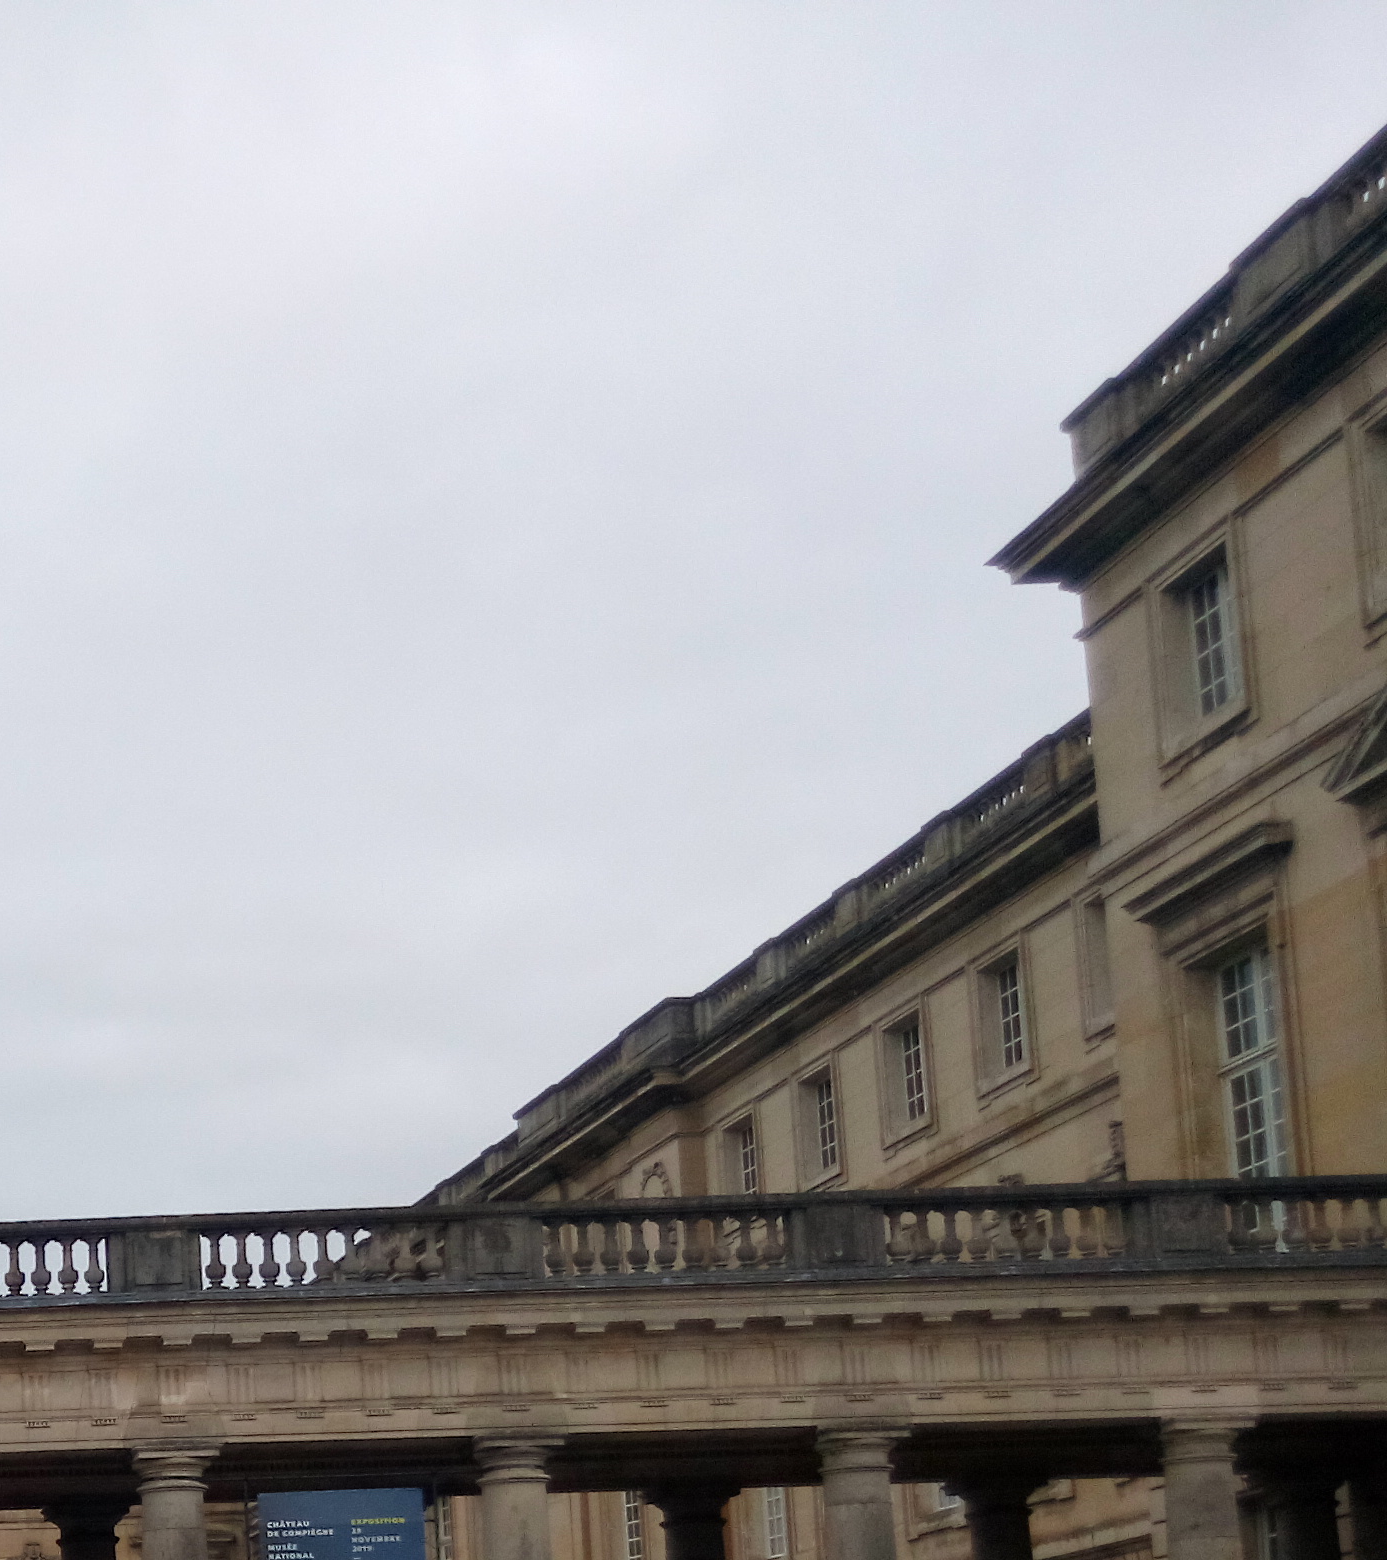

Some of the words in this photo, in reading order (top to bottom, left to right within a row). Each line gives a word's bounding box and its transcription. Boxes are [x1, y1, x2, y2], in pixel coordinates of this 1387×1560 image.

[267, 1520, 310, 1528] CHÂTEAU
[351, 1517, 406, 1526] EXPOSITION
[282, 1528, 334, 1537] COMPIÈGNE
[351, 1535, 402, 1543] NOVEMBRE
[268, 1543, 298, 1551] MUSÉE
[269, 1552, 315, 1560] NATIONAL
